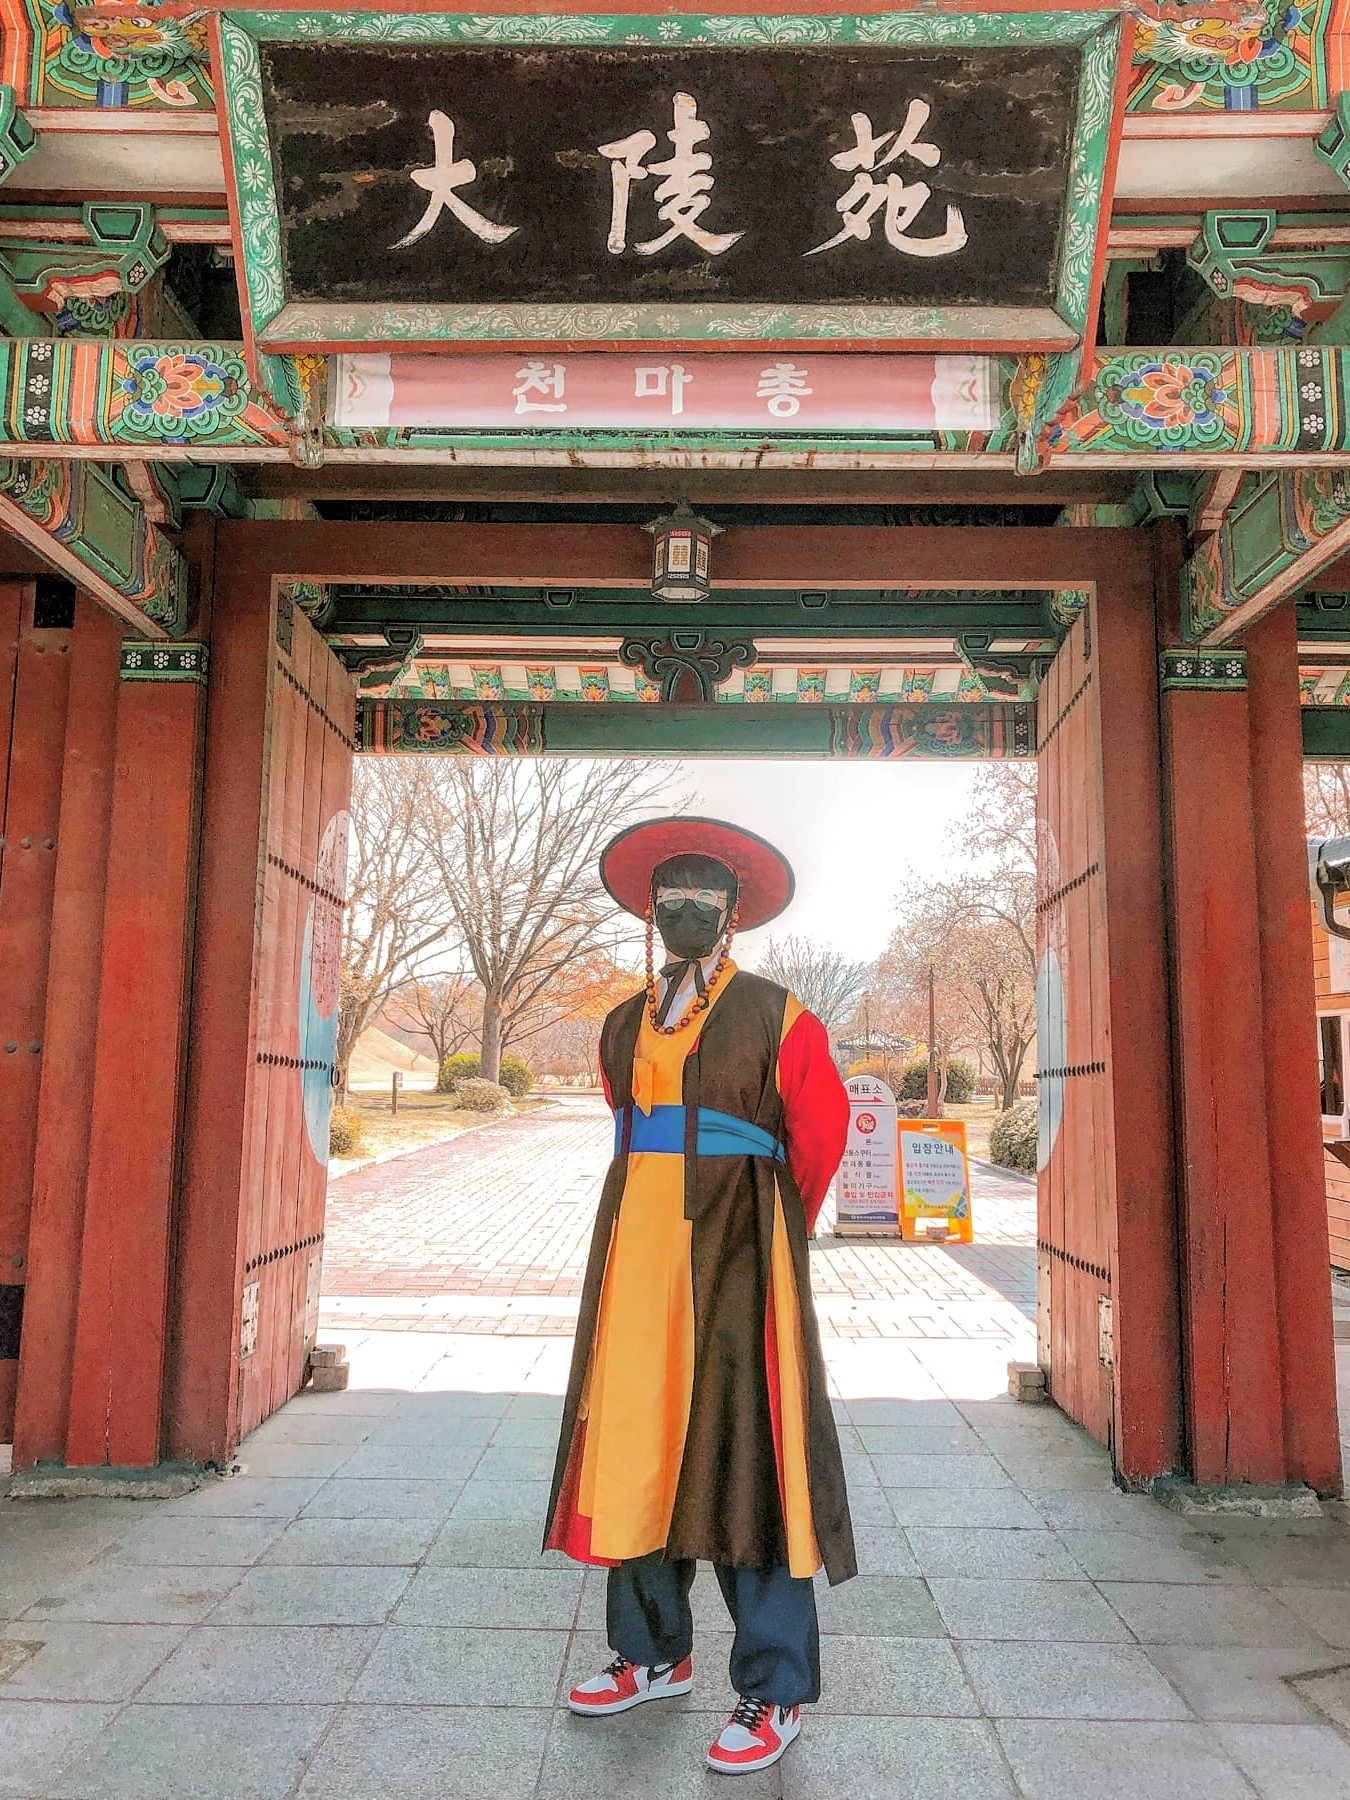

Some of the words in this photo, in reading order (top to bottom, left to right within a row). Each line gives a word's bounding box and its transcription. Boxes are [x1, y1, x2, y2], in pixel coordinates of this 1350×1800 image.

[386, 91, 969, 257] 大陵苑
[512, 361, 813, 417] 천마총
[849, 1083, 883, 1095] 매표소
[912, 1142, 954, 1156] 입장안내
